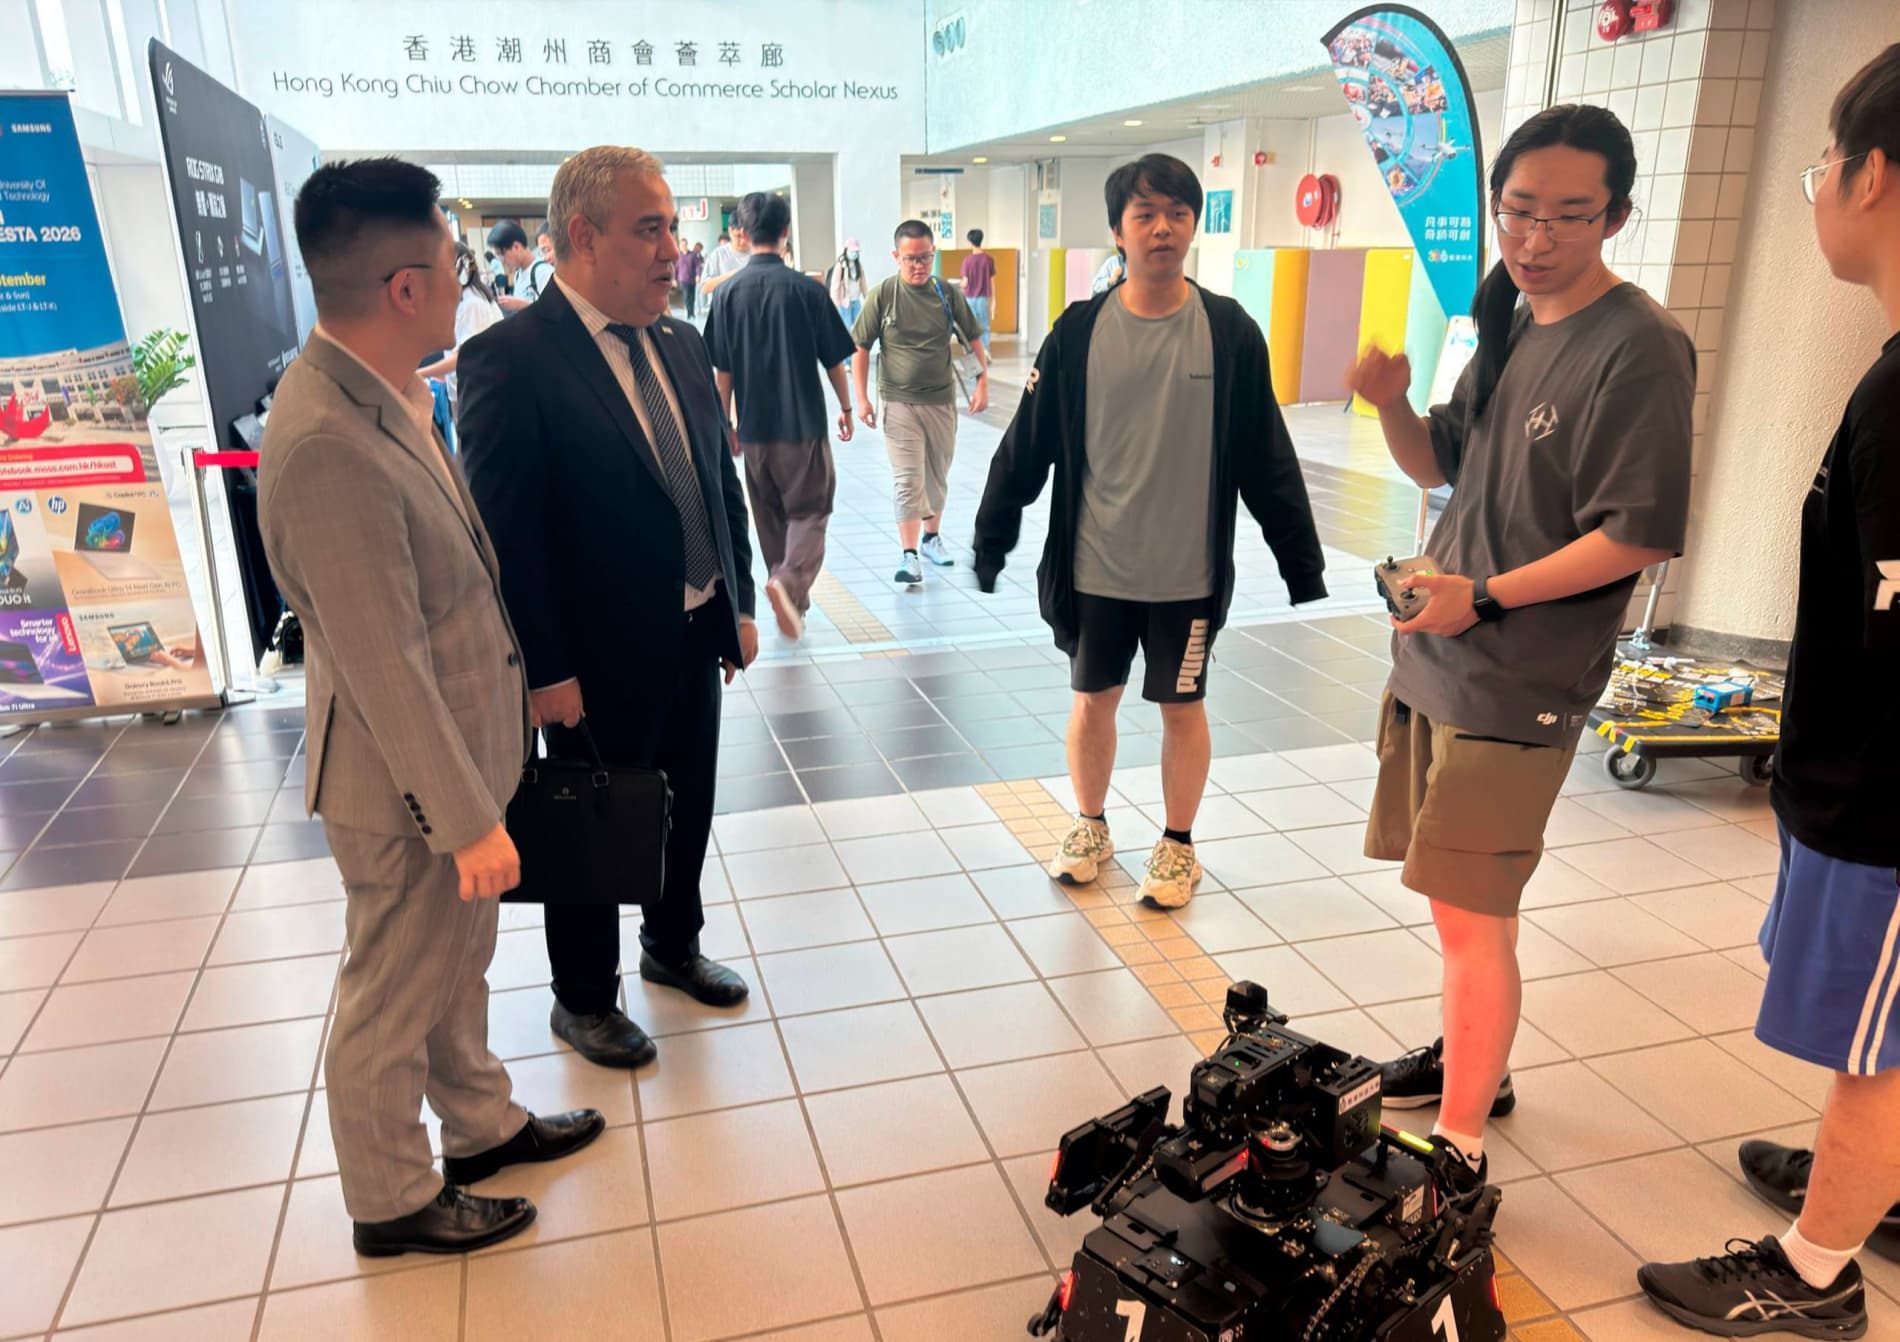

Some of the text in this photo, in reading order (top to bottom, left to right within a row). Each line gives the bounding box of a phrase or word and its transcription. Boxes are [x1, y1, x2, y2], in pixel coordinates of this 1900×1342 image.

[402, 33, 785, 69] 香港潮州商會薈萃廊
[273, 71, 898, 100] Hong Kong Chiu Chow Chamber of Commerce Scholar Nexus
[11, 123, 52, 134] SAMSUNG
[0, 180, 33, 191] niversity
[4, 191, 50, 203] Technology
[40, 226, 81, 242] 2026
[0, 271, 46, 287] tember
[49, 496, 67, 514] hp
[20, 618, 53, 628] Smarter
[79, 612, 115, 621] SAMSUNG
[10, 626, 55, 638] technology
[1431, 1293, 1459, 1342] 1
